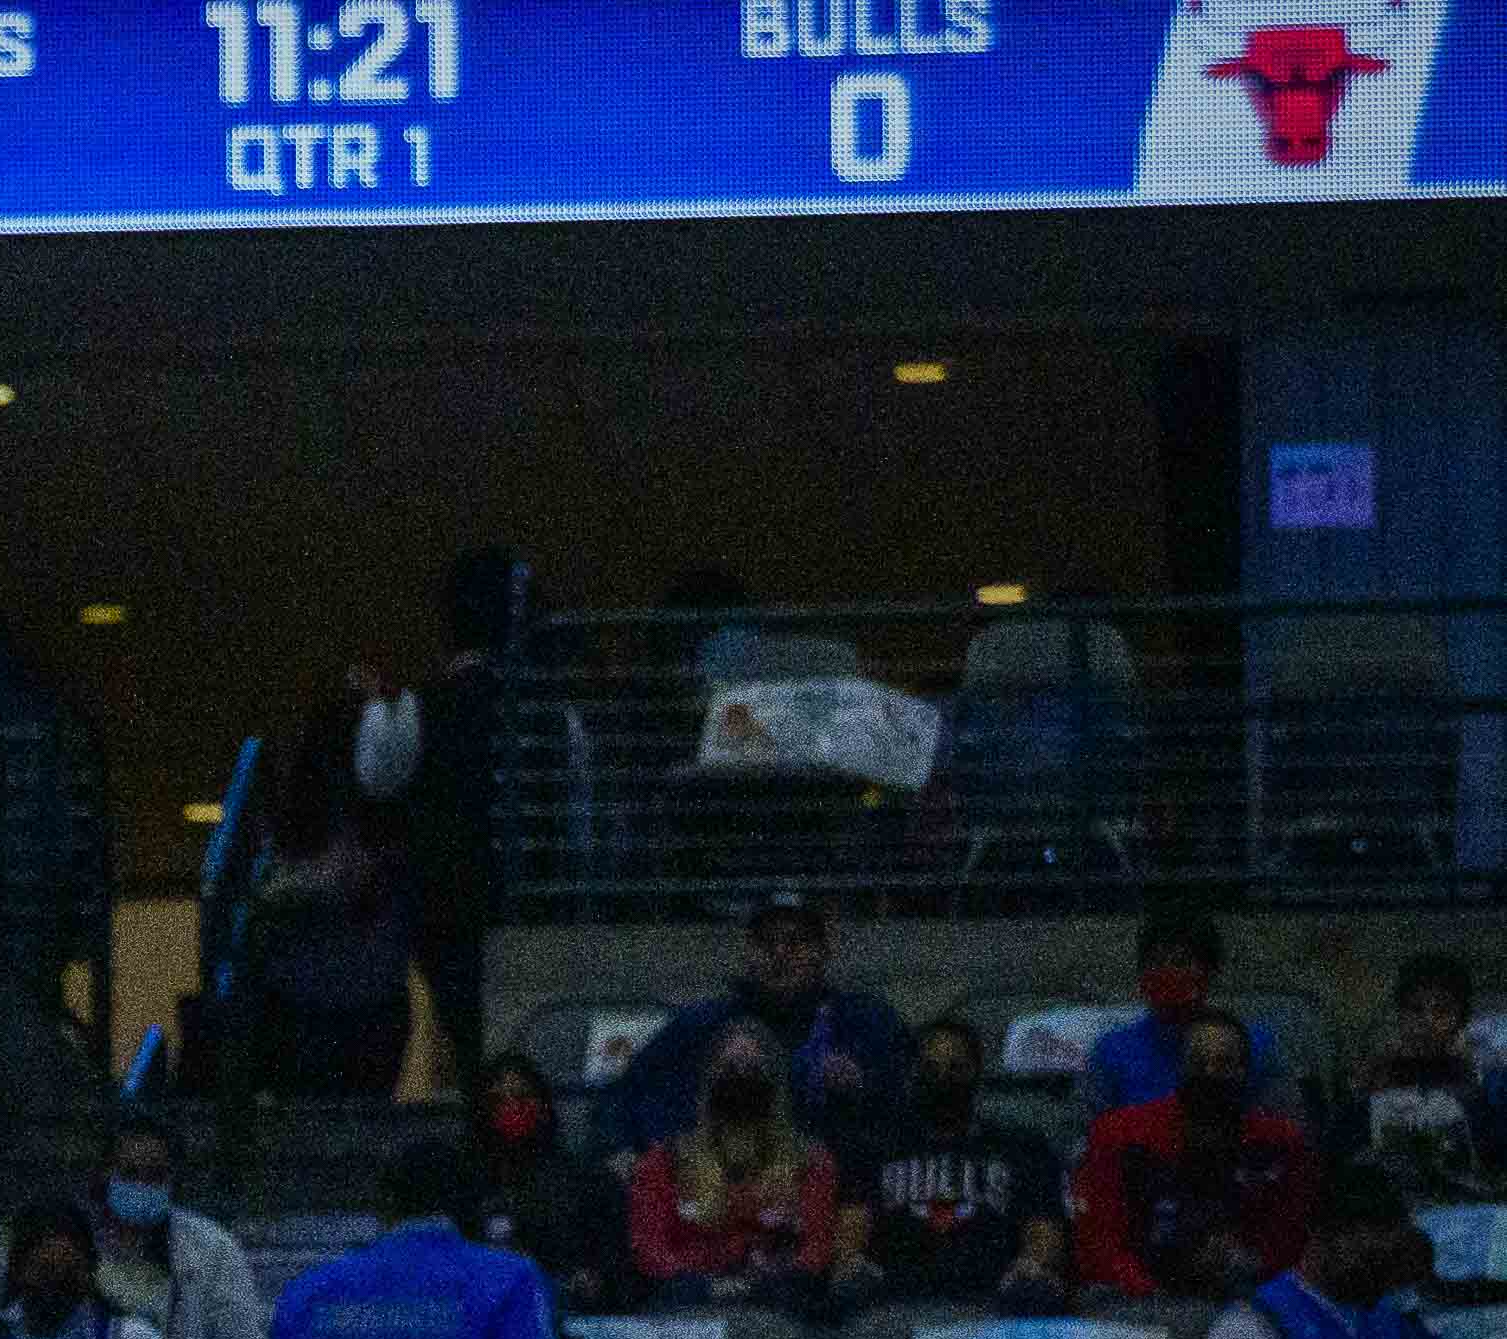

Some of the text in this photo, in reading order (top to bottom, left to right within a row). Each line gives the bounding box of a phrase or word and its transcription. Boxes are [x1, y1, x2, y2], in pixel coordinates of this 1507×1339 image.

[205, 0, 459, 105] 11:21
[740, 0, 993, 59] BULLS
[227, 123, 431, 196] QTR 1
[830, 72, 910, 183] 0
